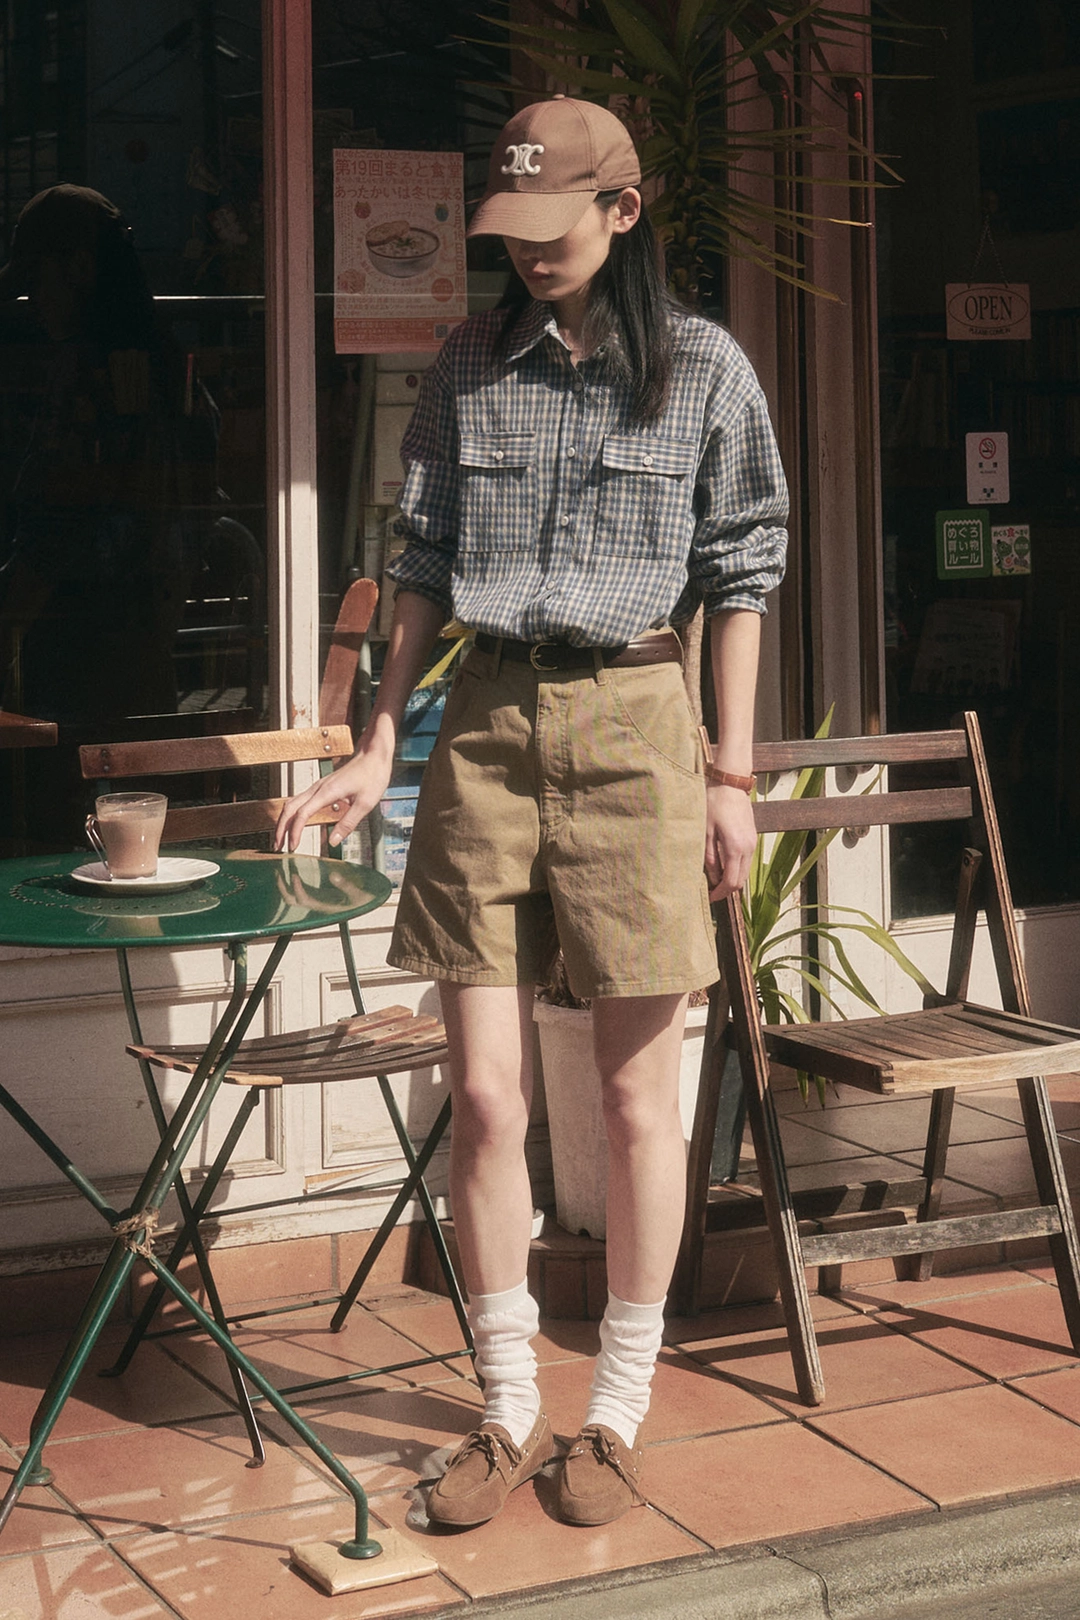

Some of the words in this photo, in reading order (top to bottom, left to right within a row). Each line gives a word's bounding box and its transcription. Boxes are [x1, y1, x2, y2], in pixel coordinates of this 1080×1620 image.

[335, 159, 463, 178] 第19回まると食堂
[335, 185, 463, 200] あったかいは冬に来る
[964, 295, 1012, 320] OPEN
[947, 527, 979, 539] めぐろ
[947, 540, 980, 553] 買い物
[948, 553, 980, 564] ルール
